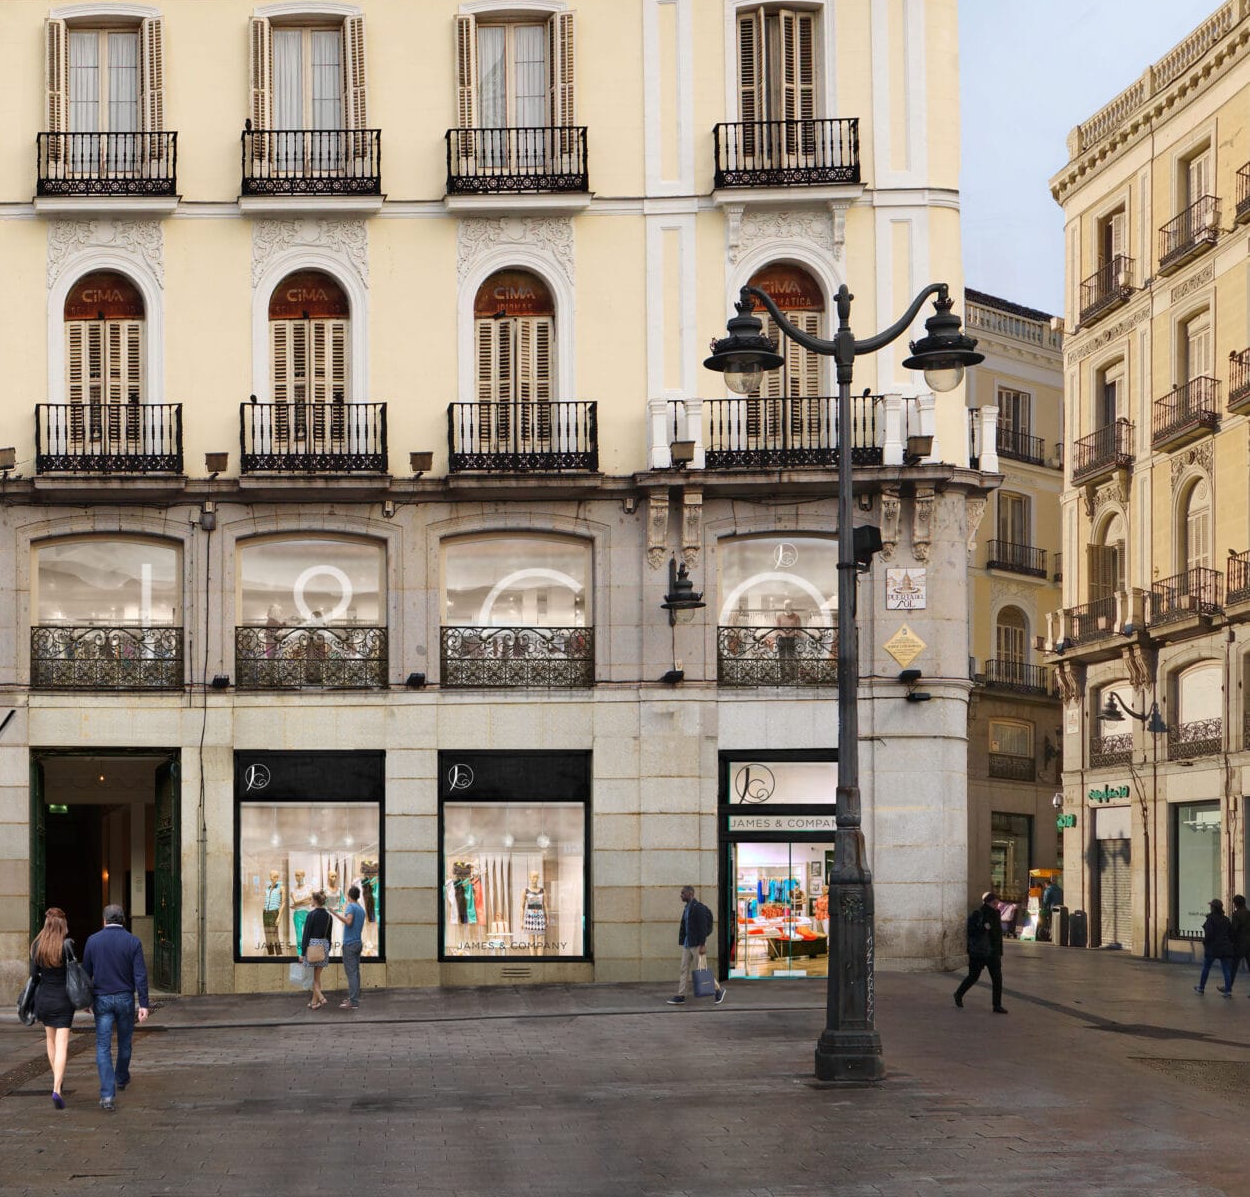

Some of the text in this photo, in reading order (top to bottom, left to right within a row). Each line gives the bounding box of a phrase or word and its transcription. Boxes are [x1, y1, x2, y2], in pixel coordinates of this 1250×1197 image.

[730, 819, 837, 828] JAMES & COMPAN
[456, 941, 567, 950] JAMES & COMPANY
